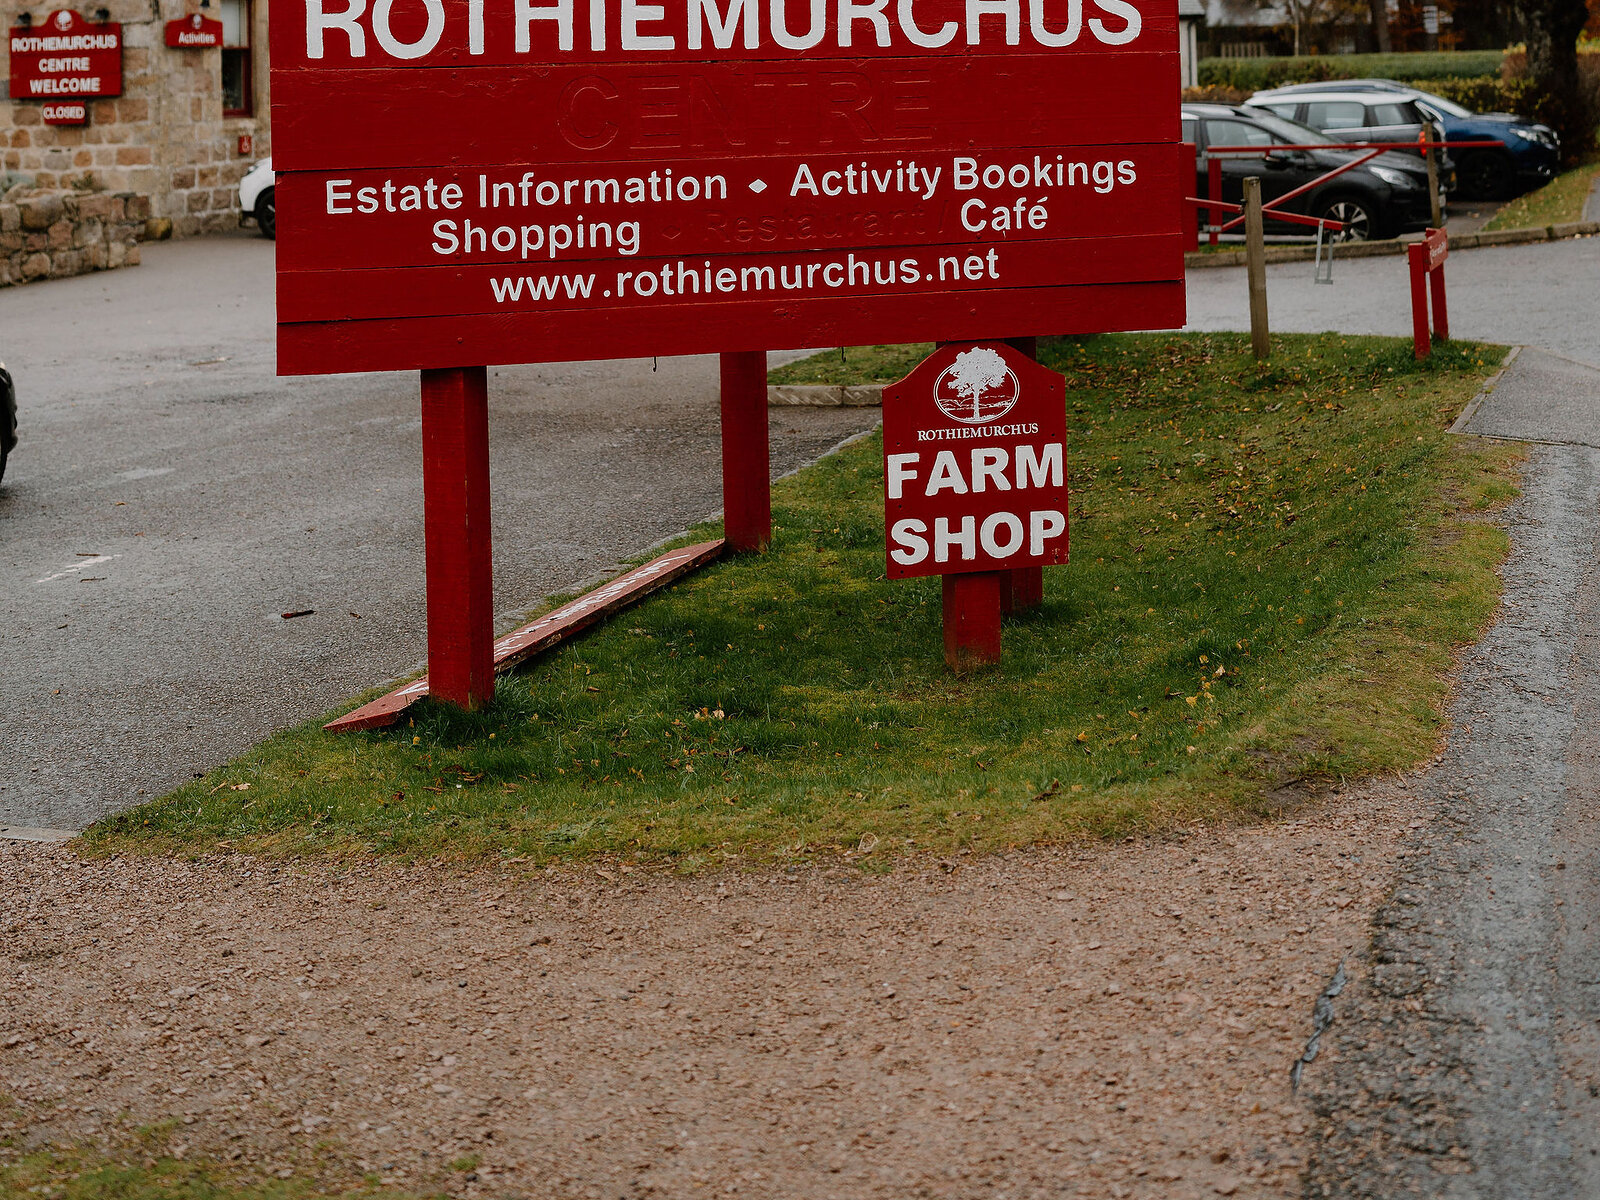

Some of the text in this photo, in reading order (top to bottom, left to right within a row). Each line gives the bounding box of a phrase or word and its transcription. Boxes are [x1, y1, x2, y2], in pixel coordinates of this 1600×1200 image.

[178, 31, 217, 45] Activities
[38, 56, 91, 73] CENTRE
[29, 77, 101, 94] WELCOME
[43, 106, 86, 120] CLOSED
[325, 154, 1137, 215] Estate Information Activity Bookings
[431, 214, 640, 259] Shopping
[960, 196, 1049, 233] Café
[489, 247, 1001, 303] www.rothiemurchus.net
[916, 422, 1039, 442] ROTHIEMURCHUS
[887, 442, 1064, 500] FARM
[890, 510, 1066, 566] SHOP
